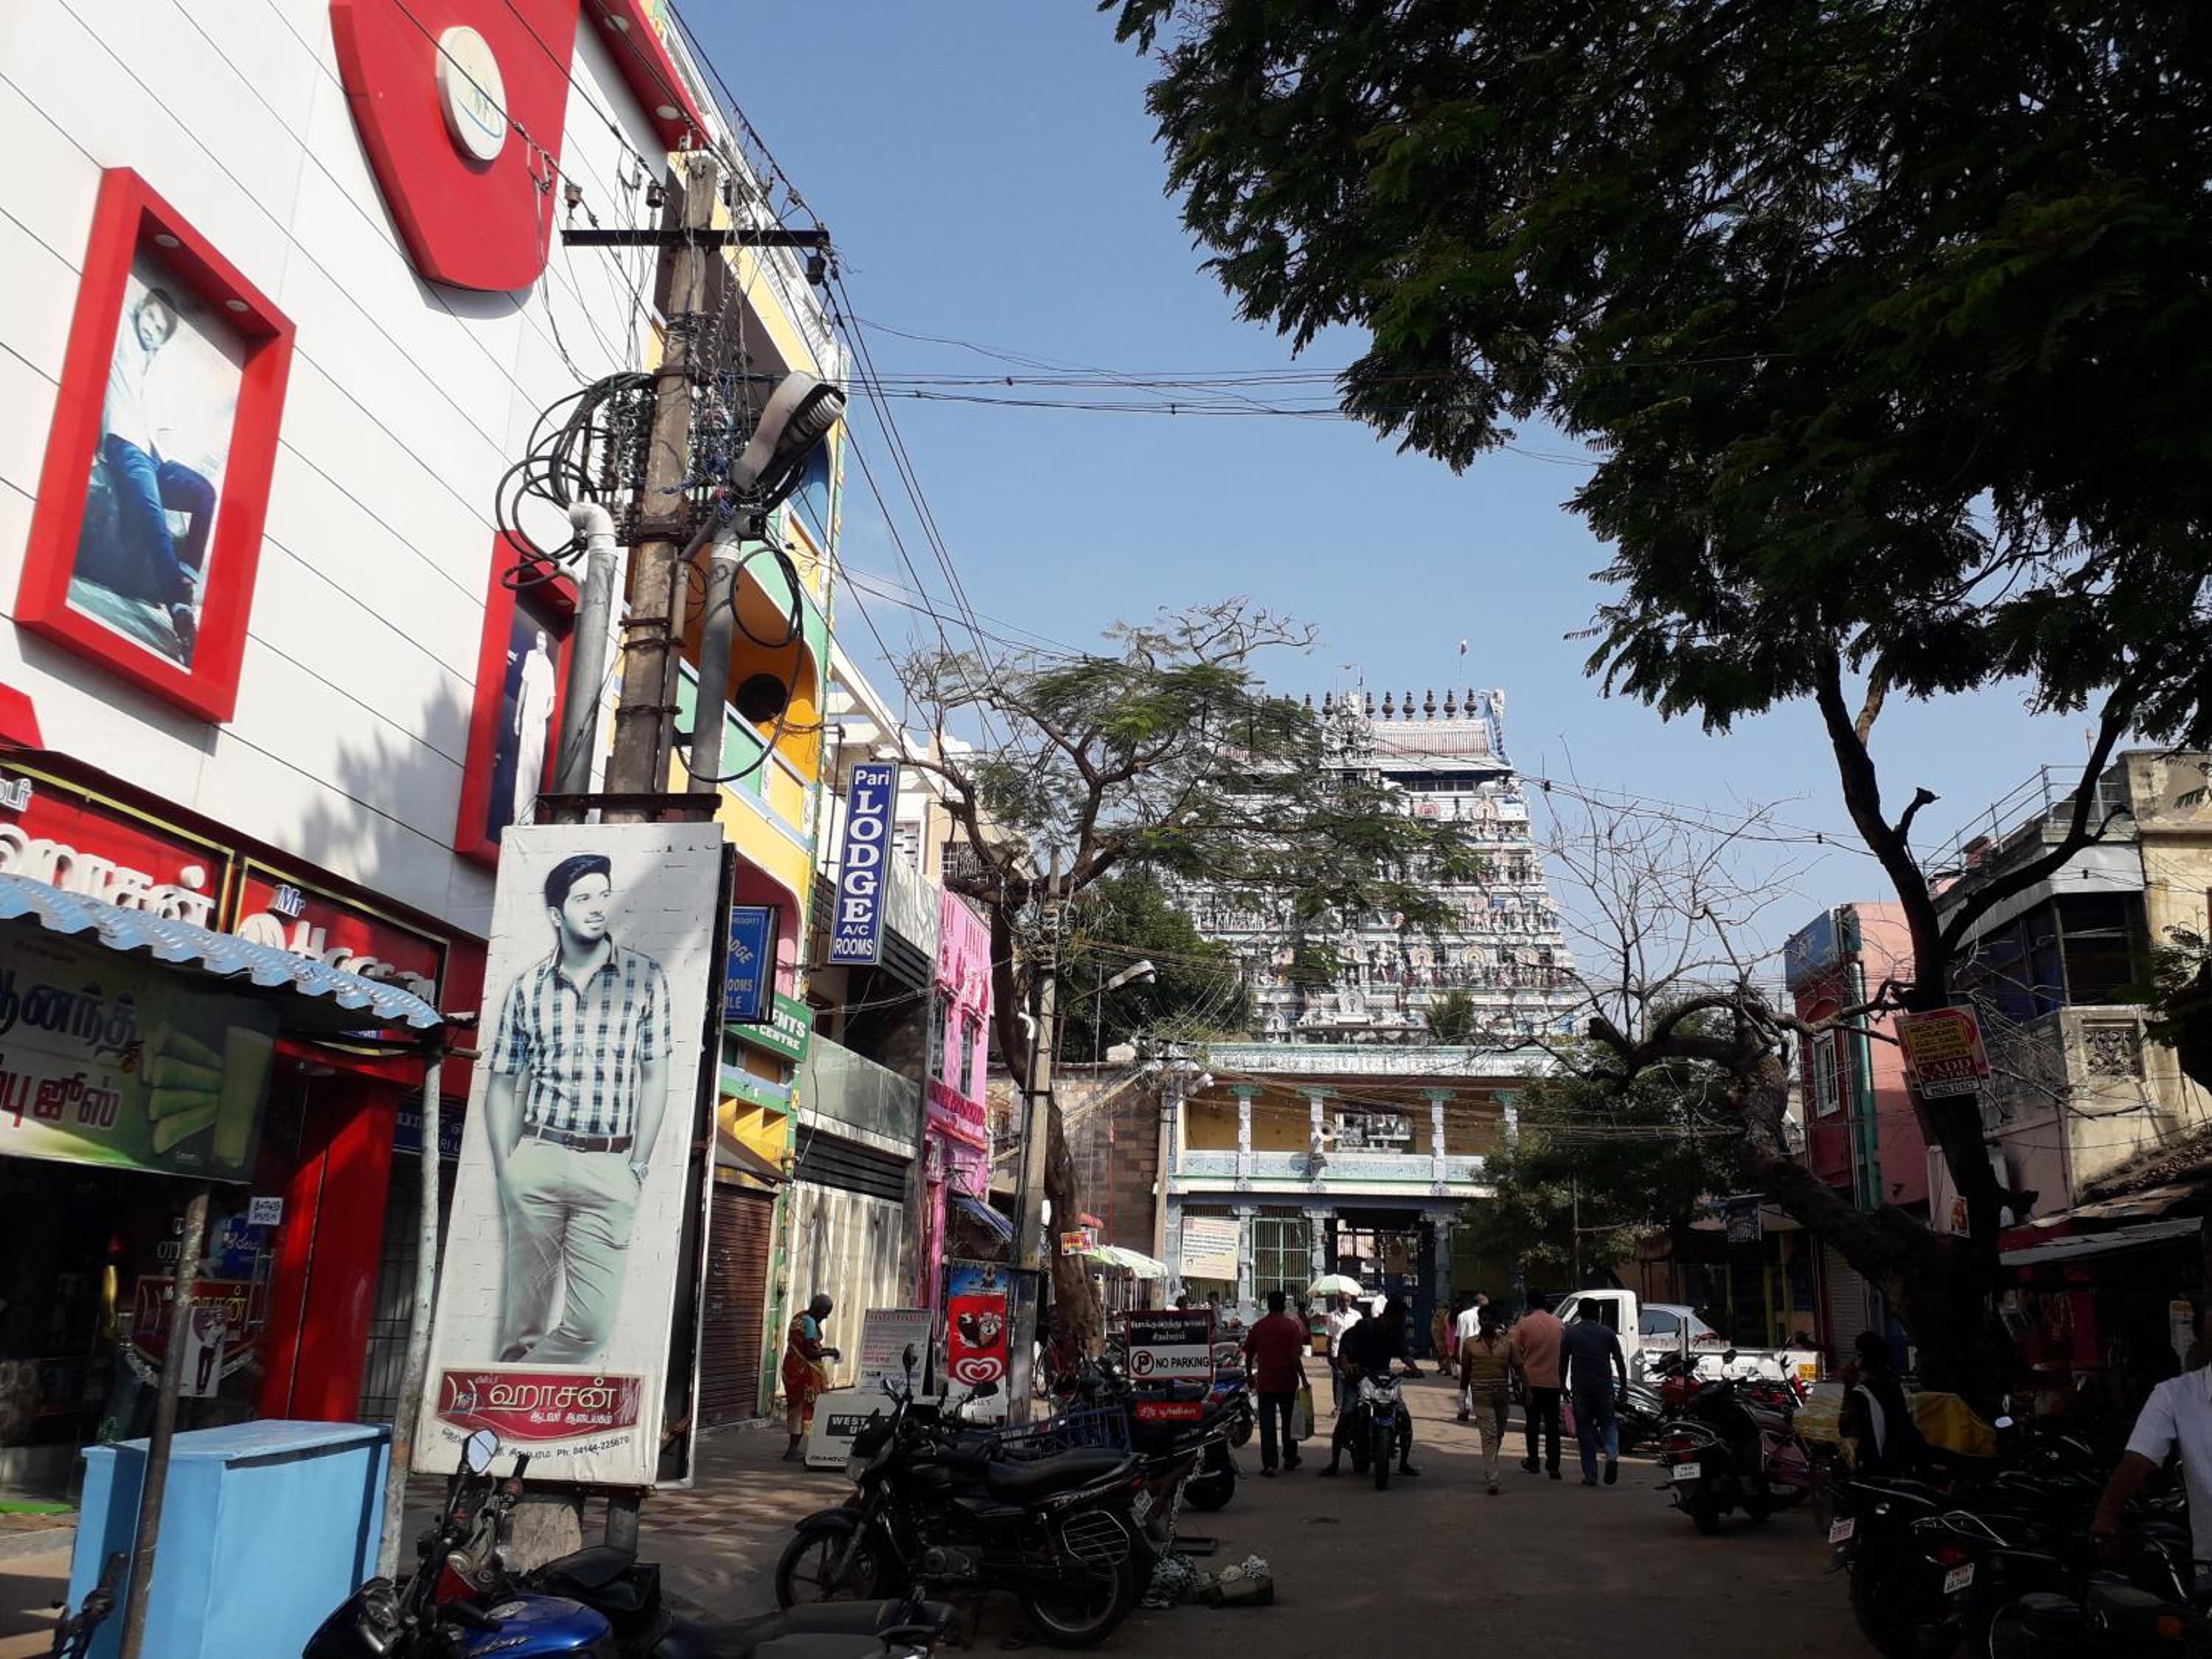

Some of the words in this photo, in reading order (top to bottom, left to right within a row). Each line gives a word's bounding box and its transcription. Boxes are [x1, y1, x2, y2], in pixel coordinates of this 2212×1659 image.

[855, 770, 889, 785] Pari
[842, 790, 883, 922] LODGE
[275, 885, 306, 917] Mr
[842, 924, 869, 936] A/C
[729, 935, 754, 964] DGE
[834, 938, 873, 956] ROOMS
[727, 978, 753, 992] OOMS
[772, 1008, 805, 1039] ENTS
[759, 1024, 800, 1051] CENTRE
[1918, 1059, 1971, 1076] CADD
[1155, 1357, 1169, 1368] NO
[1171, 1357, 1209, 1368] PARKING
